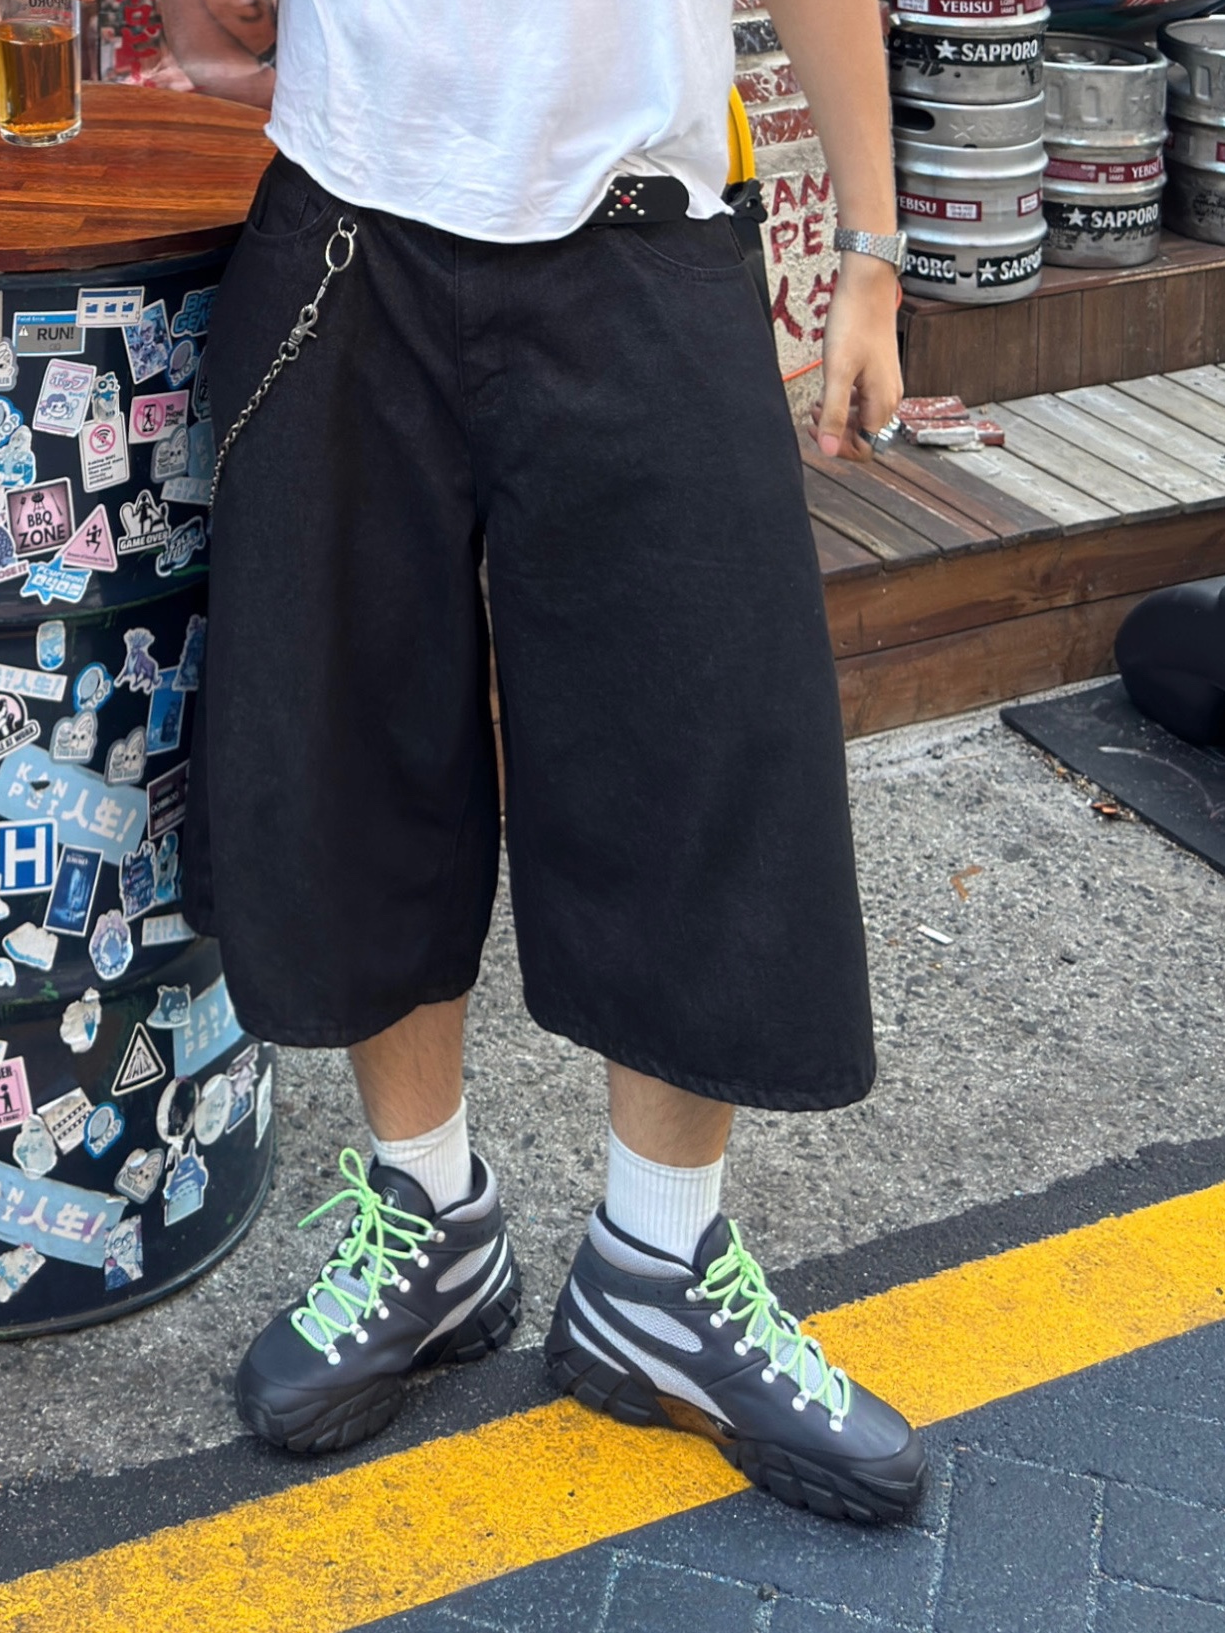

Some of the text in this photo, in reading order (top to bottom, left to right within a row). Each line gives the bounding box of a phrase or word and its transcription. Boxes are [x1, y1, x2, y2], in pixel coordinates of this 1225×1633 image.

[940, 0, 993, 14] YEBISU
[961, 39, 1038, 62] SAPPORO
[765, 172, 829, 216] AN
[896, 196, 937, 214] EBISU
[1091, 203, 1159, 228] SAPPORO
[770, 212, 825, 264] PE
[905, 254, 955, 279] PORO
[36, 326, 75, 341] RUN!
[27, 510, 53, 527] BBQ
[18, 524, 66, 548] ZONE
[120, 531, 168, 550] GAME OVER
[18, 563, 28, 572] IT
[14, 726, 34, 742] WORK
[16, 762, 69, 798] KAN
[61, 788, 137, 843] 人生!
[4, 826, 47, 888] H
[185, 1023, 220, 1058] PEI
[93, 1120, 122, 1152] STOP
[18, 1195, 107, 1244] 人生!
